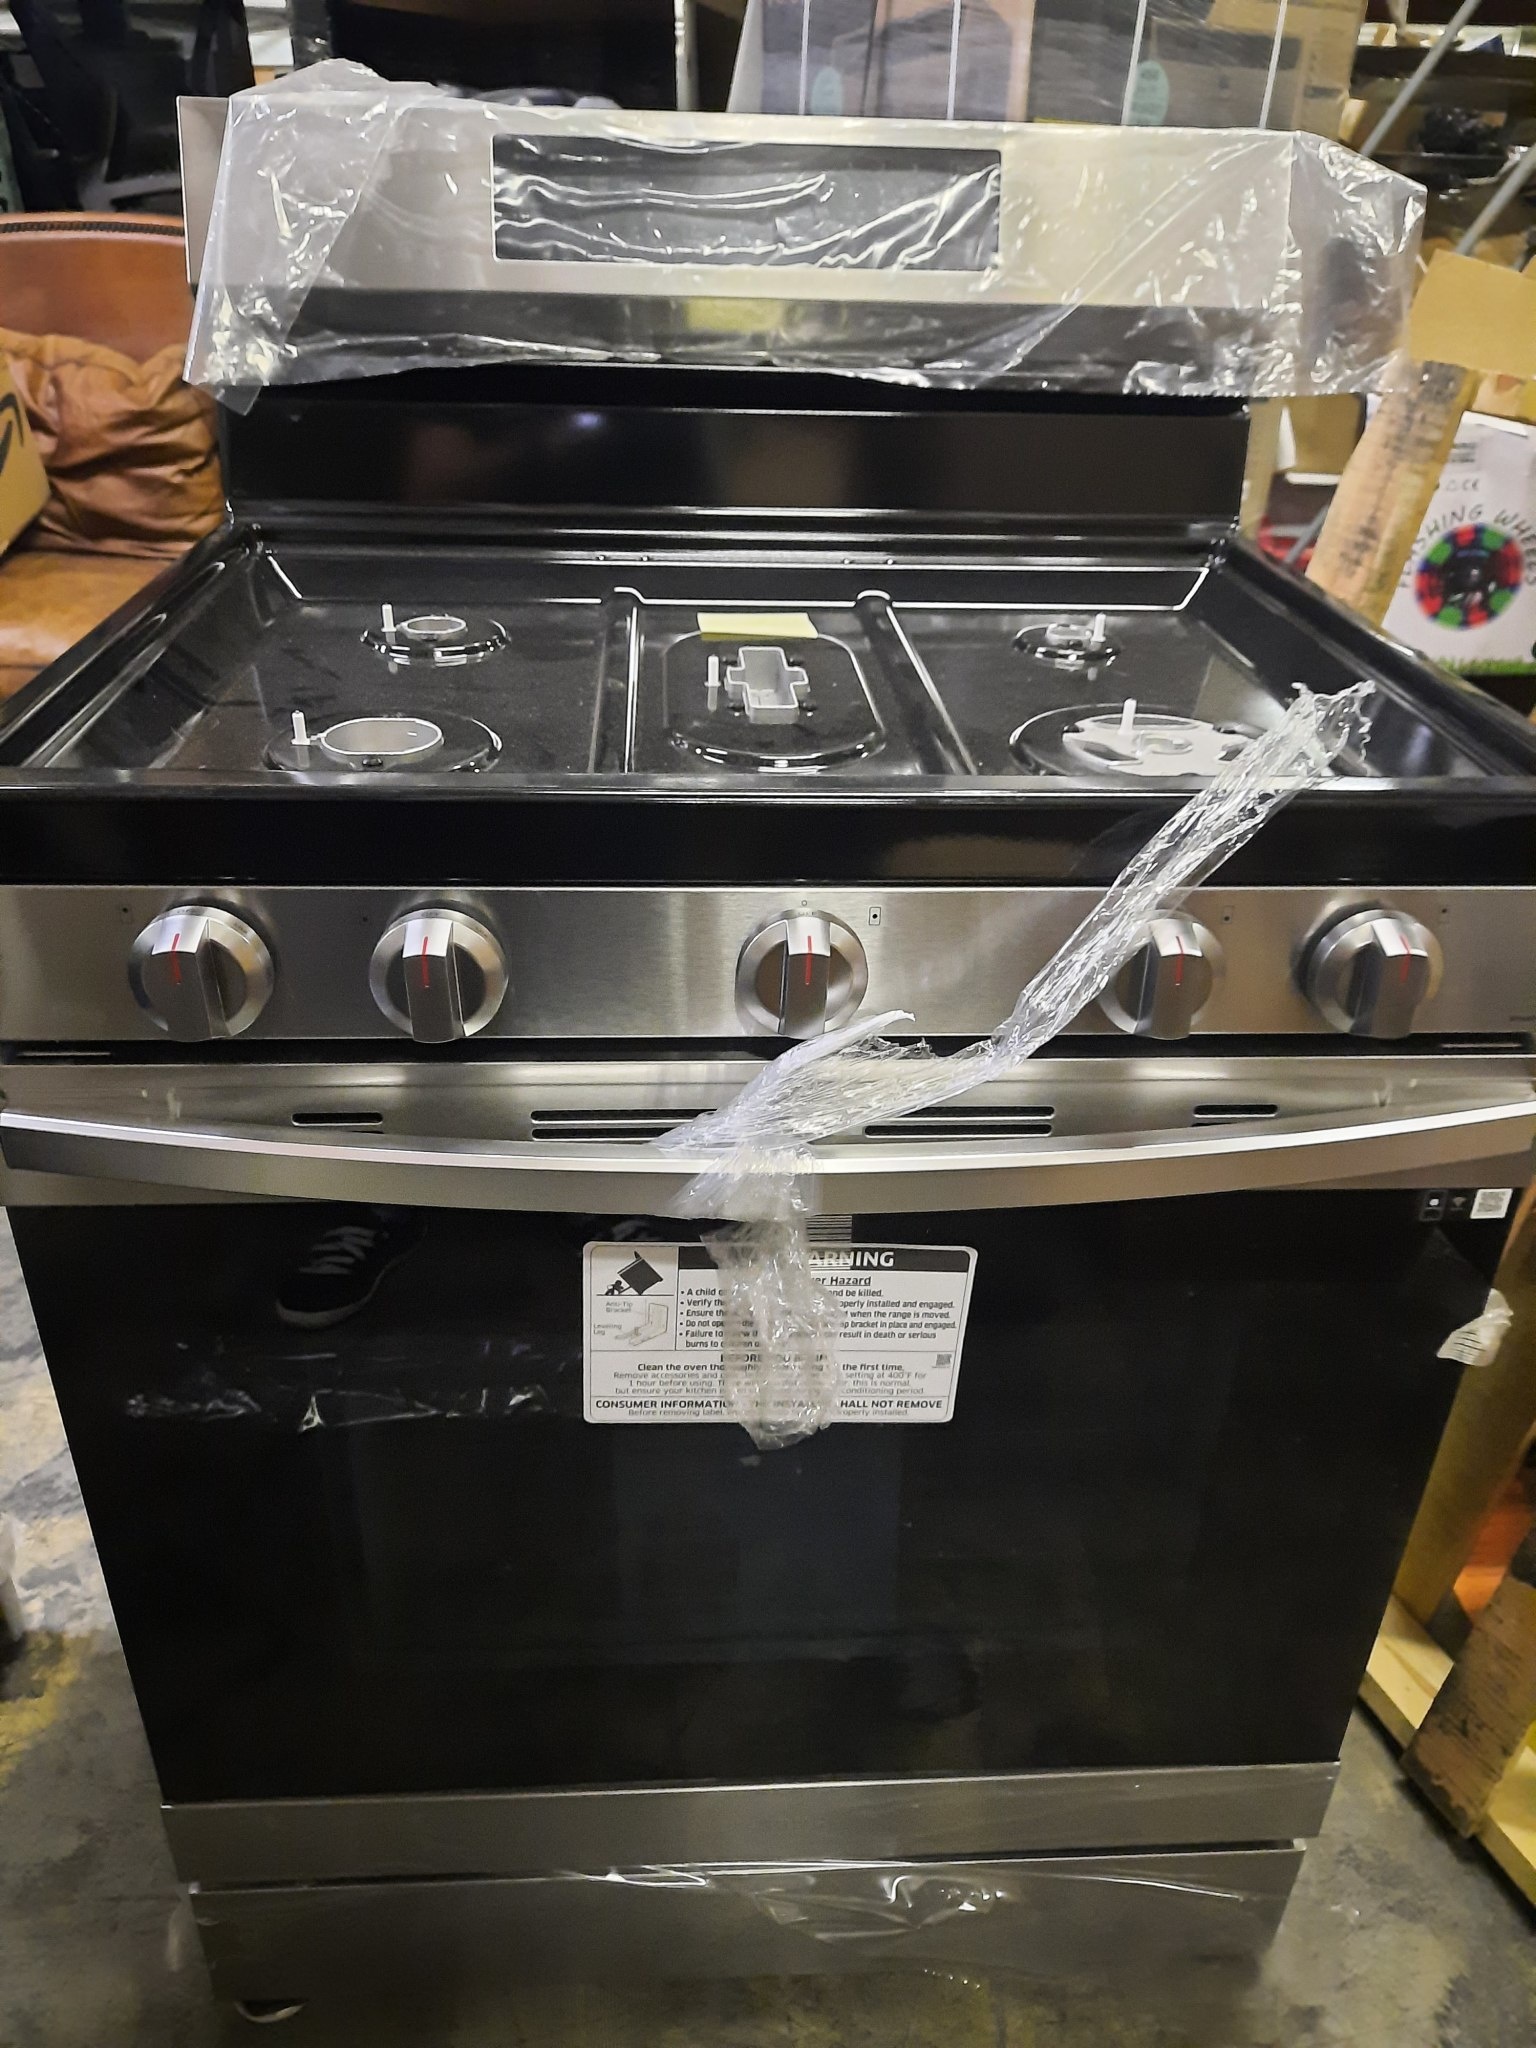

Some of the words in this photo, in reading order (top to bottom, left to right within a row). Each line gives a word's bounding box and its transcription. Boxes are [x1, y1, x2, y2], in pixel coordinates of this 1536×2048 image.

[808, 1251, 894, 1268] ARNING
[830, 1276, 872, 1286] Hazard
[687, 1288, 693, 1296] A
[695, 1288, 716, 1296] child
[846, 1289, 856, 1297] be
[687, 1299, 712, 1308] Verify
[866, 1299, 901, 1308] installed
[902, 1300, 918, 1308] and
[686, 1309, 714, 1317] Ensure
[850, 1310, 872, 1318] when
[873, 1310, 887, 1318] the
[888, 1311, 912, 1320] range
[698, 1319, 710, 1327] not
[850, 1320, 878, 1329] bracket
[880, 1320, 887, 1328] in
[888, 1321, 908, 1330] place
[909, 1321, 923, 1329] and
[685, 1330, 713, 1338] Failure
[873, 1331, 896, 1339] death
[908, 1331, 937, 1339] serious
[685, 1340, 709, 1348] burns
[710, 1340, 719, 1348] to
[637, 1363, 664, 1371] Clean
[666, 1363, 681, 1371] the
[842, 1363, 858, 1371] the
[860, 1363, 879, 1371] first
[613, 1371, 649, 1379] Remove
[701, 1371, 718, 1379] and
[845, 1372, 875, 1380] setting
[914, 1371, 927, 1379] for
[636, 1379, 656, 1387] hour
[659, 1379, 687, 1387] before
[852, 1379, 868, 1387] this
[870, 1379, 878, 1387] is
[615, 1387, 629, 1395] but
[664, 1388, 682, 1396] your
[685, 1387, 717, 1395] kitchen
[595, 1399, 657, 1409] CONSUMER
[840, 1399, 868, 1408] HALL
[871, 1399, 894, 1409] NOT
[896, 1399, 943, 1409] REMOVE
[659, 1409, 700, 1417] removing
